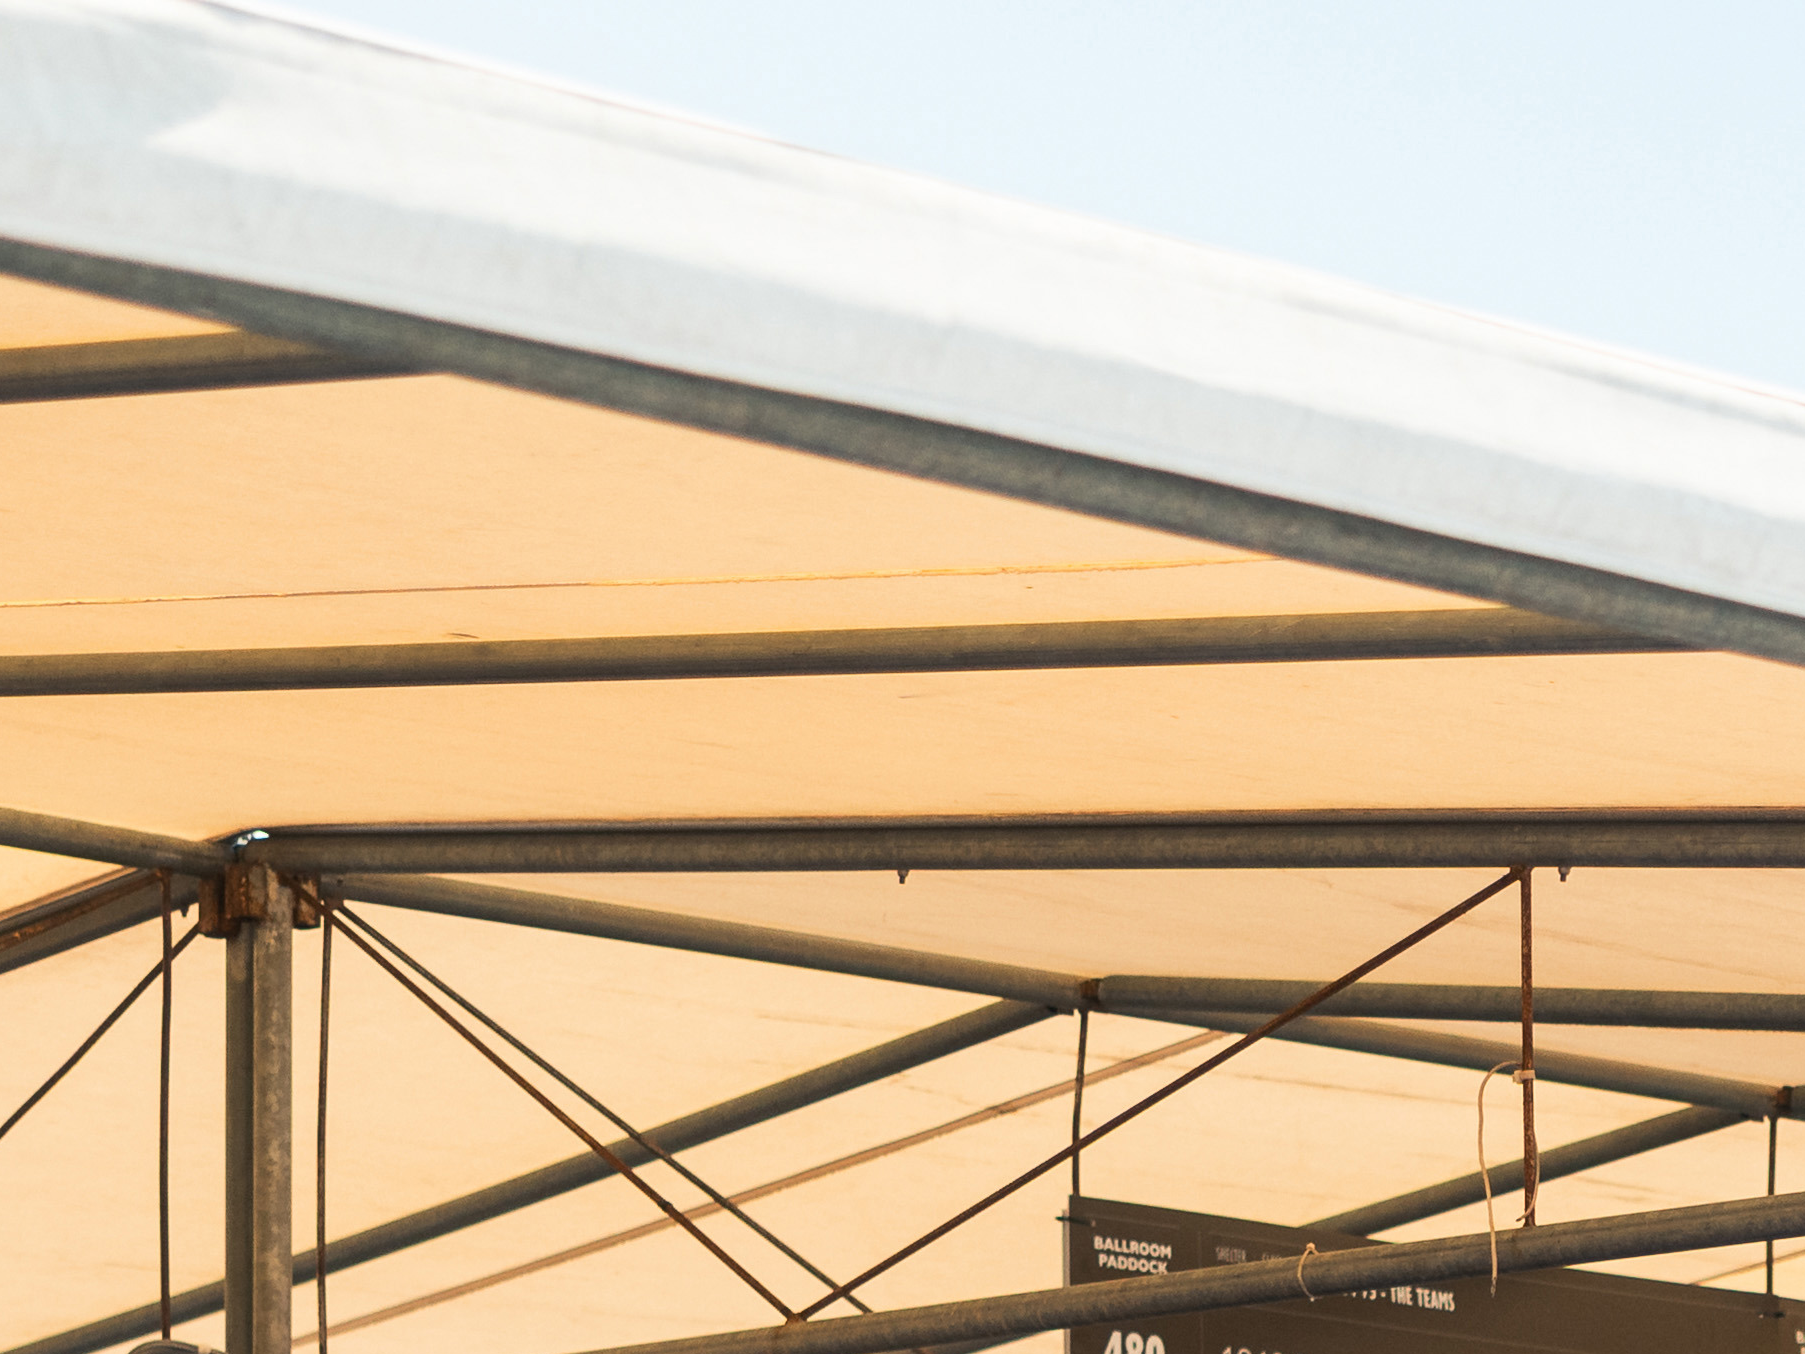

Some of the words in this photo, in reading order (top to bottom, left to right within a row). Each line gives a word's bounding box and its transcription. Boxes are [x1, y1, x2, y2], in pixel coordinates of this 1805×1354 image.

[1094, 1236, 1172, 1259] BALLROOM
[1098, 1253, 1168, 1275] PADDOCK
[1390, 1286, 1413, 1306] THE
[1416, 1287, 1456, 1312] TEAMS
